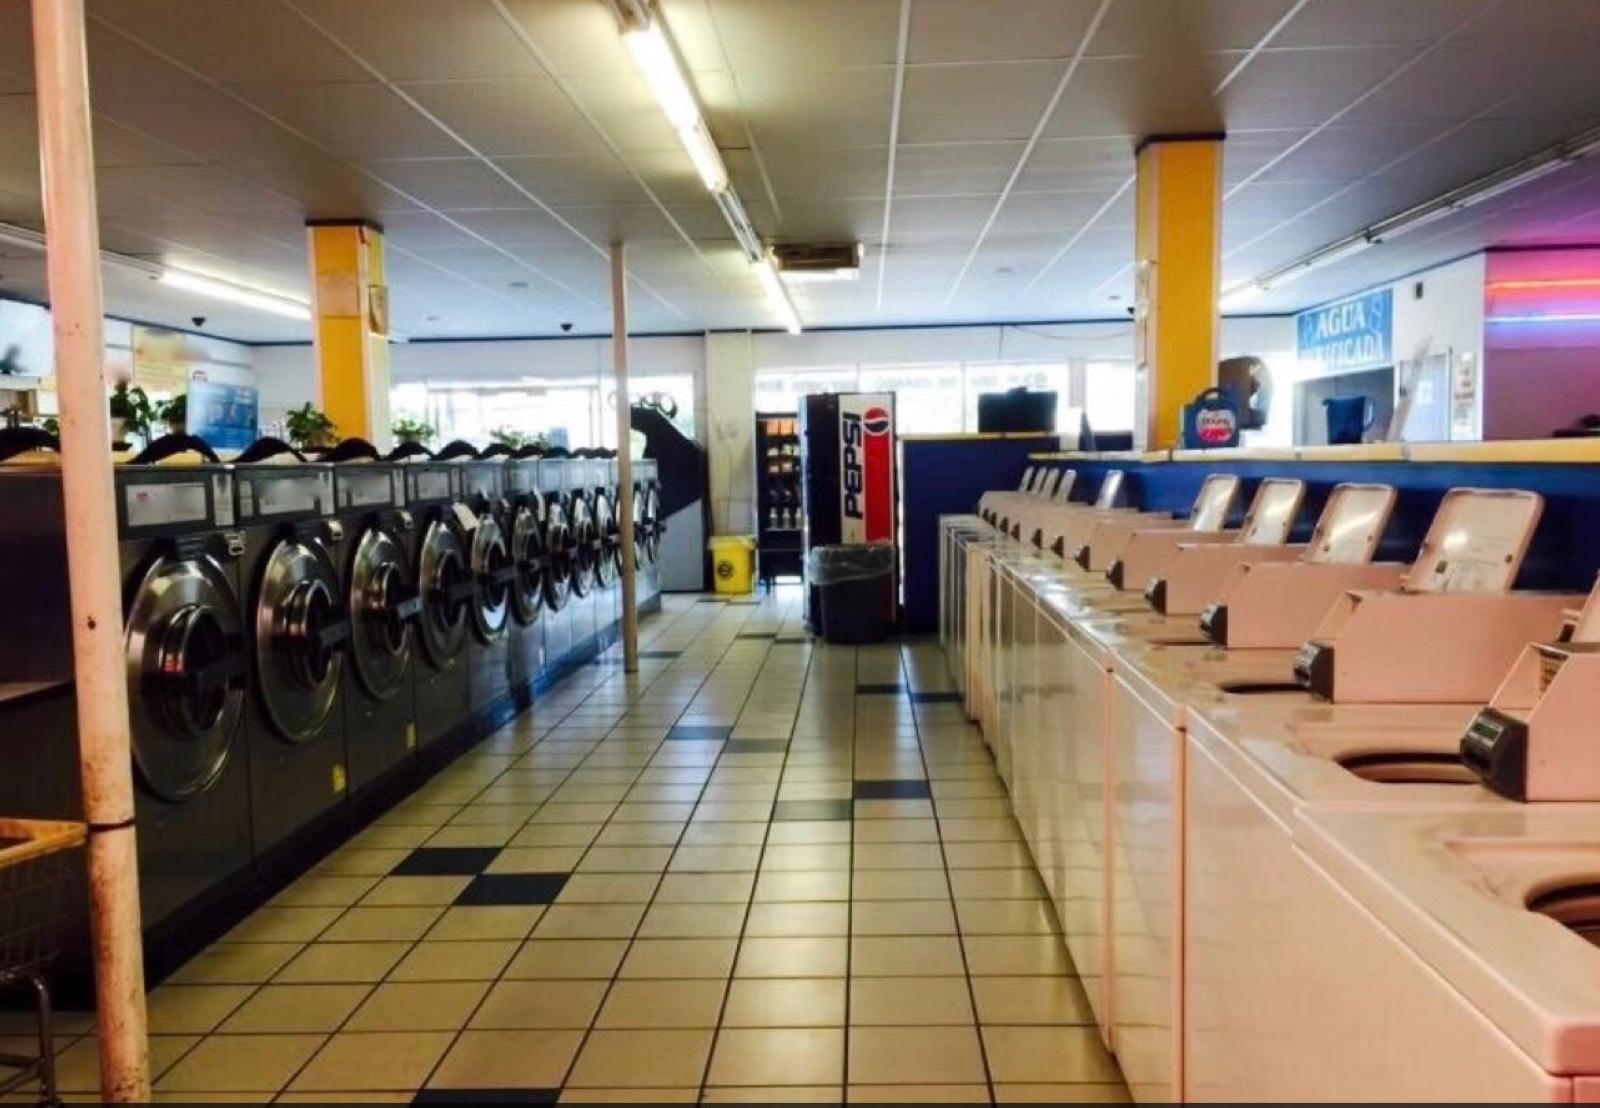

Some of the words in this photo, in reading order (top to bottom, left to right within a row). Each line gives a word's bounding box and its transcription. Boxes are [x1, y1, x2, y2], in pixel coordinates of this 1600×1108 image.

[1316, 301, 1366, 340] AGUA
[1301, 332, 1385, 368] IFICADA
[842, 411, 864, 520] PEPSI
